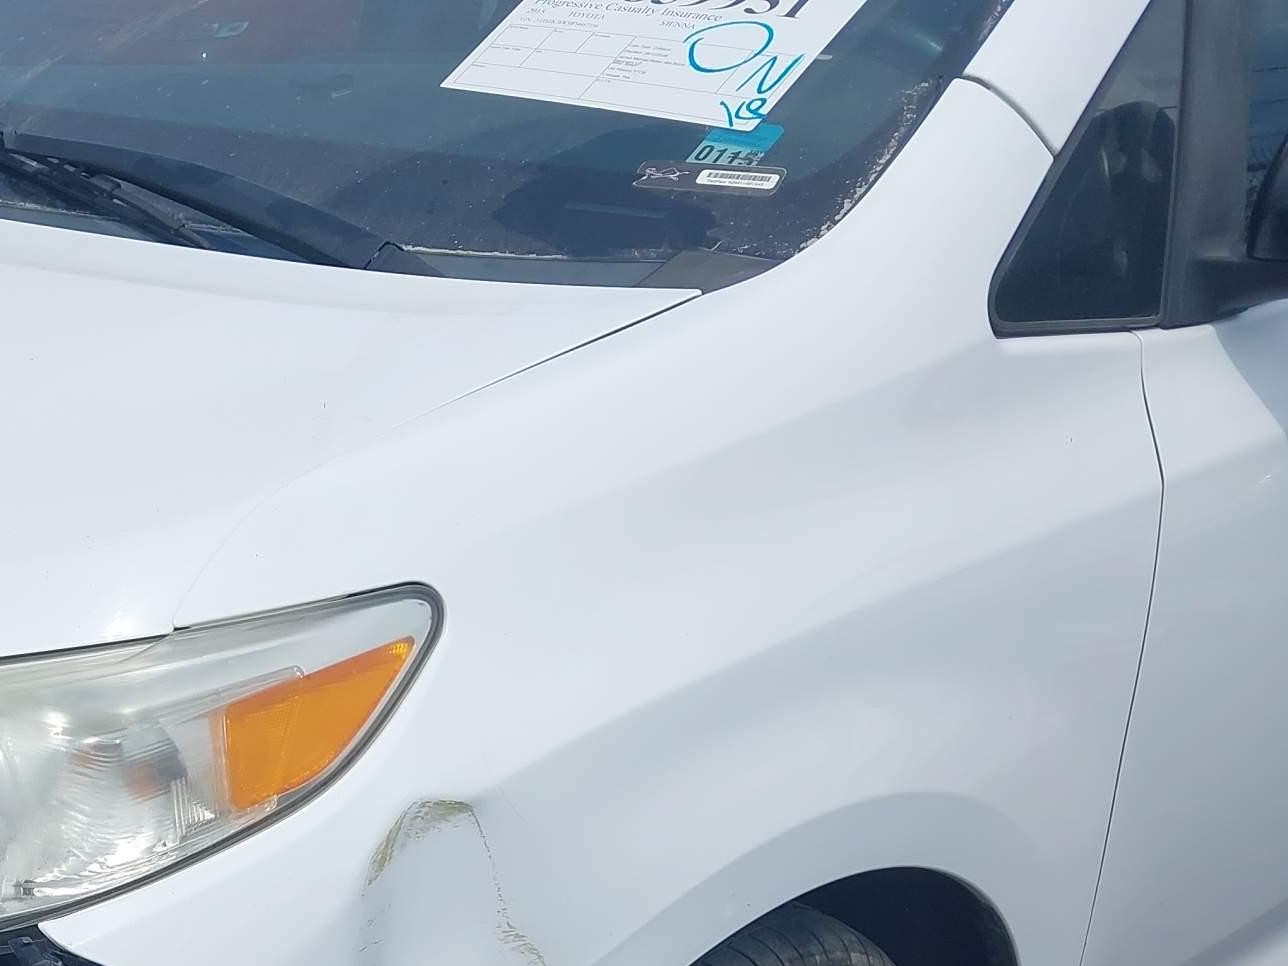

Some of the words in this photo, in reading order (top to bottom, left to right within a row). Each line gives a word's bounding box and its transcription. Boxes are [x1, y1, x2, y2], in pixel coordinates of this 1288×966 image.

[568, 11, 605, 19] TOYOTA
[659, 20, 696, 30] SIENNA
[605, 2, 658, 16] Casualty
[661, 7, 723, 22] Insurance
